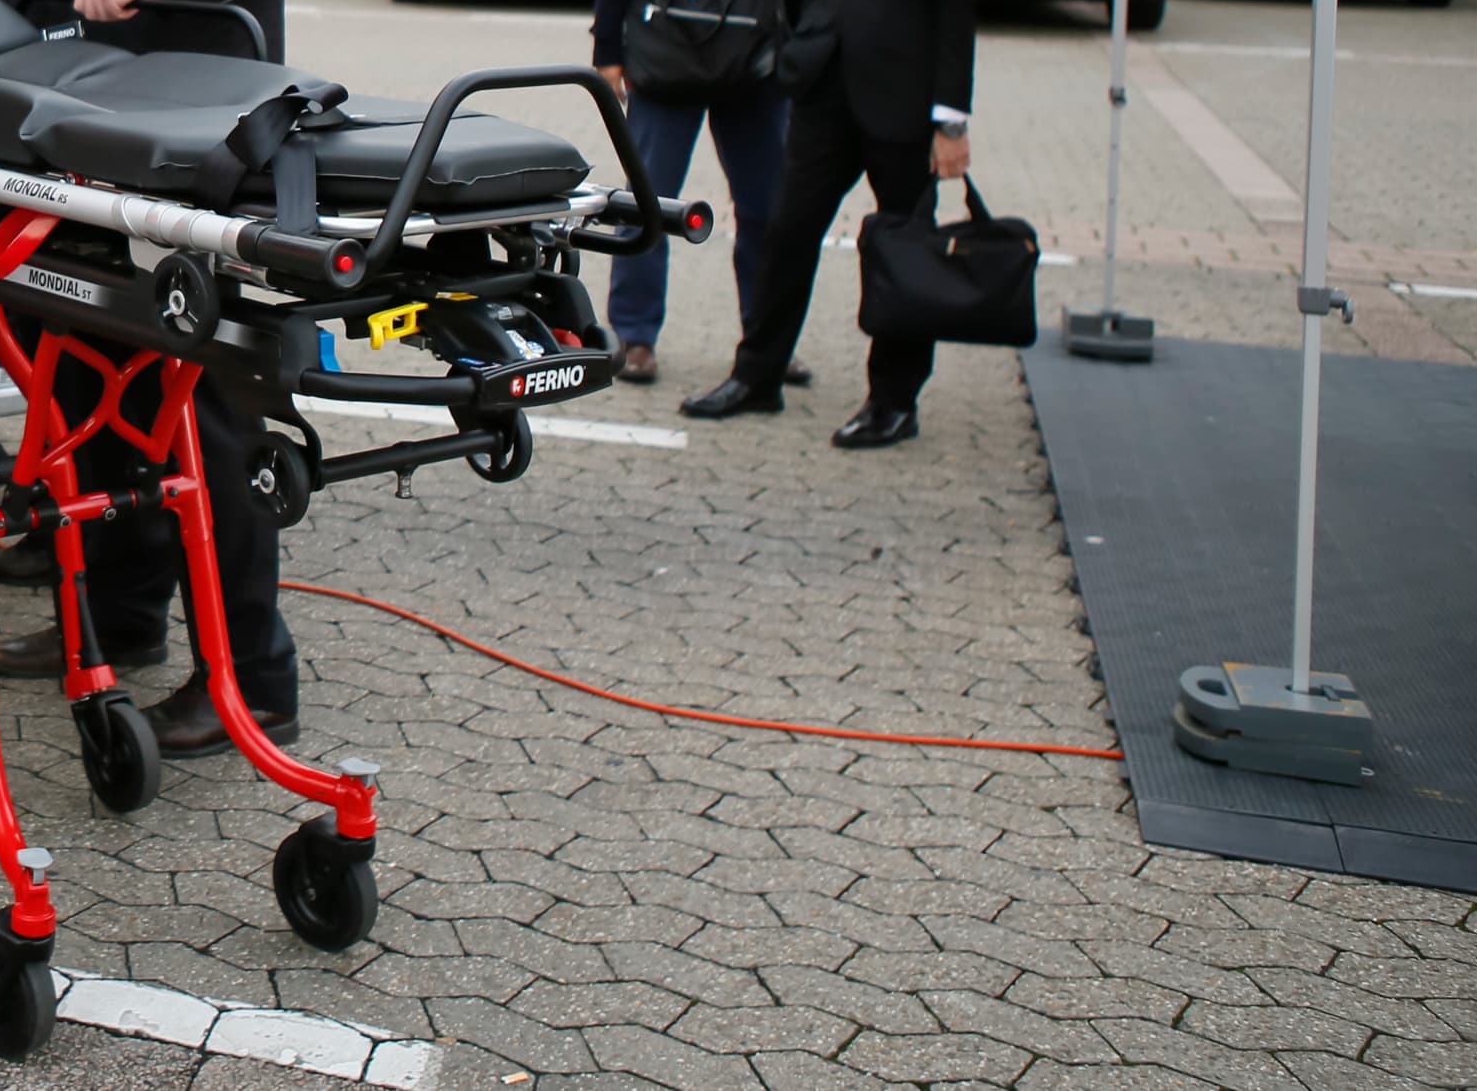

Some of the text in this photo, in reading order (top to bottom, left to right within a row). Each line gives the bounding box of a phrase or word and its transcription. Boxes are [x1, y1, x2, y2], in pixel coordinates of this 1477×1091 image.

[49, 27, 76, 40] FERNO
[4, 177, 58, 202] MONDIAL
[28, 269, 92, 300] MONDIAL ST
[524, 364, 585, 396] FERNO
